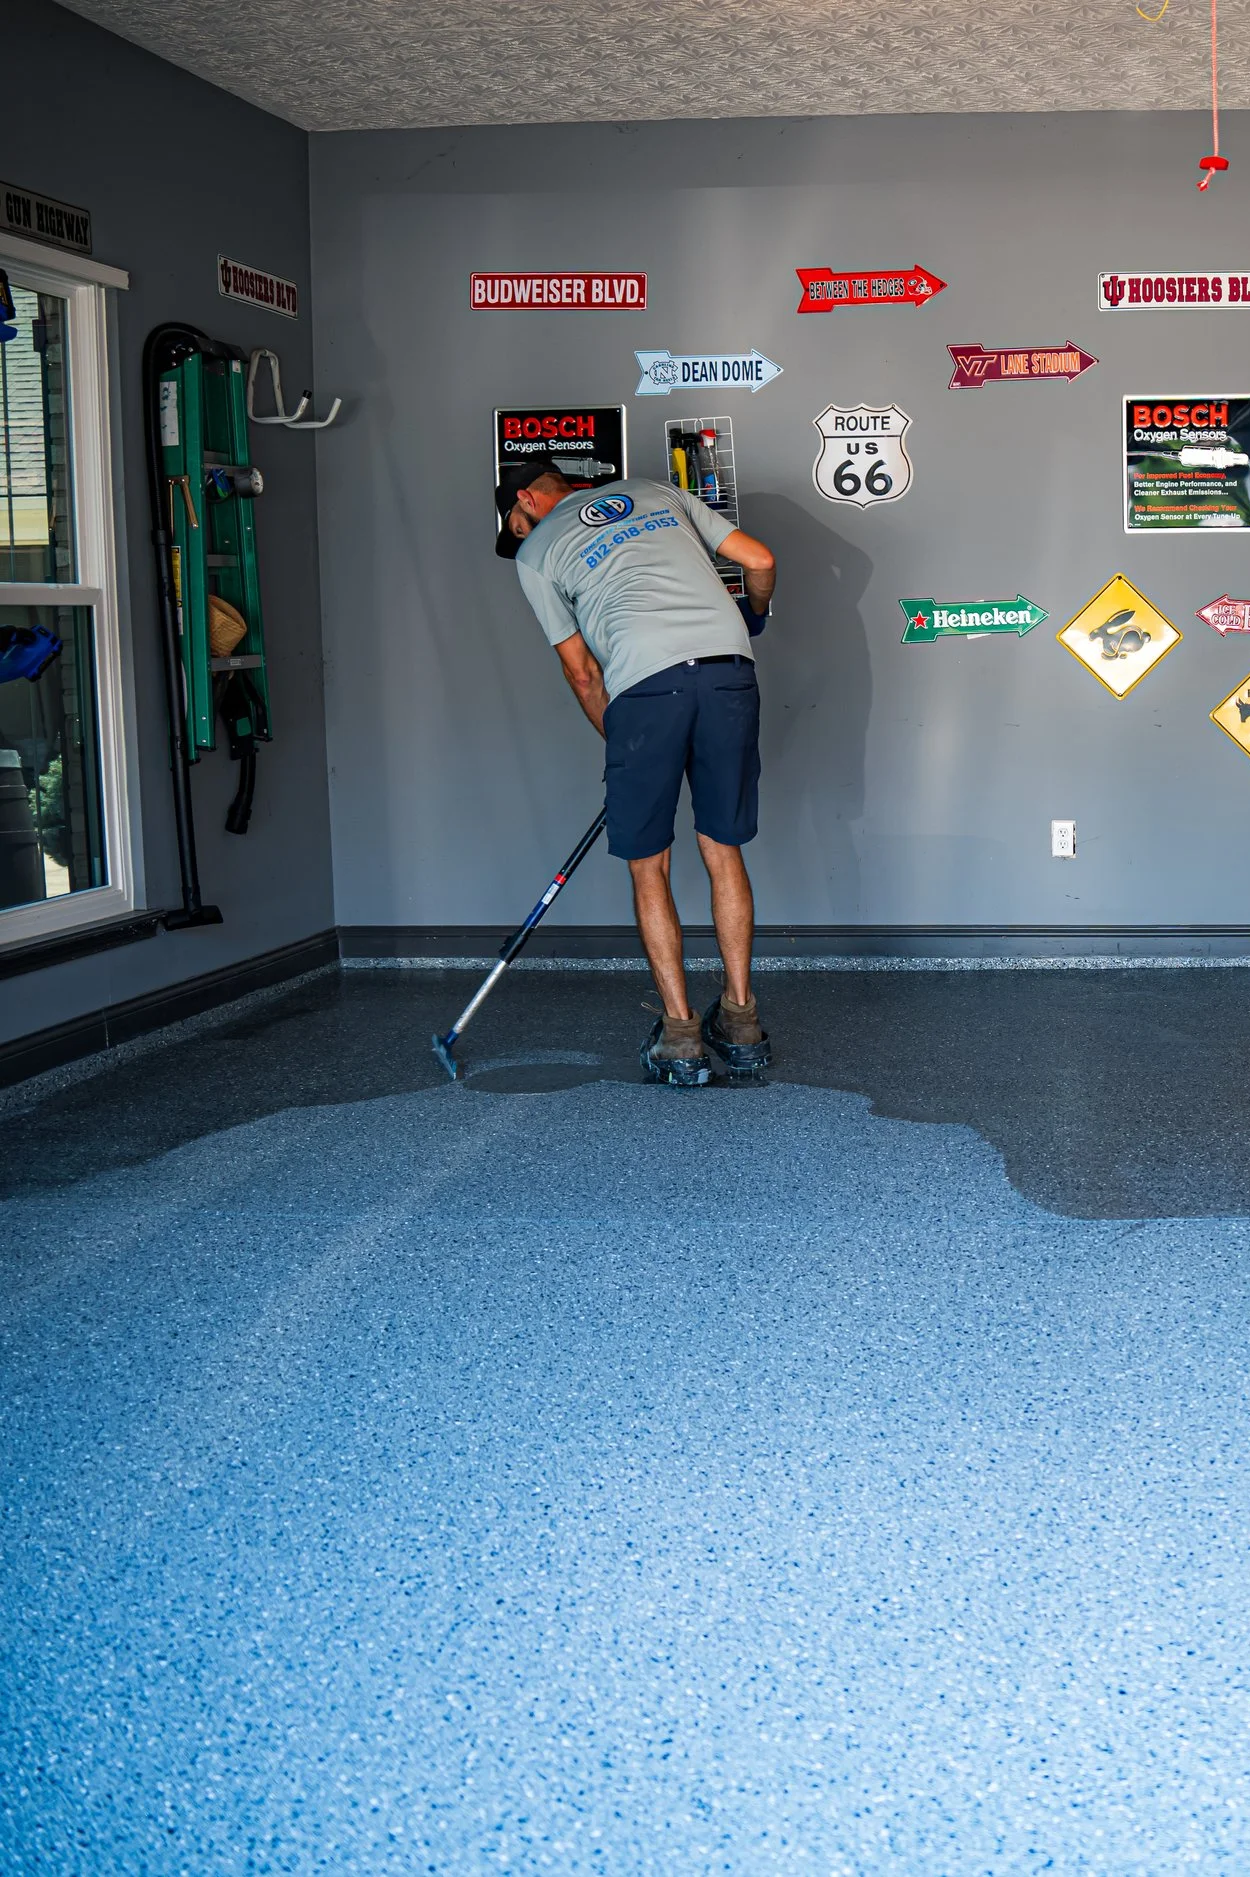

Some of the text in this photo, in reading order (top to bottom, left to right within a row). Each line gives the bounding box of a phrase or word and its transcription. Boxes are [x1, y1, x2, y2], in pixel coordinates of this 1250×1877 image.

[6, 192, 31, 228] GUN
[36, 201, 88, 246] HIGHWAY
[232, 265, 275, 305] HOOSIERS
[276, 281, 297, 312] BLVD
[474, 279, 645, 304] BUDWEISER BLVD.
[809, 278, 904, 300] BETWEEN THE HEDGES
[1128, 277, 1222, 303] HOOSIERS
[682, 361, 718, 382] DEAN
[722, 360, 763, 381] DOME
[1000, 354, 1029, 375] LANE
[1031, 351, 1080, 374] STADIUM
[835, 416, 890, 431] ROUTE
[1134, 404, 1228, 428] BOSCH
[504, 416, 595, 439] BOSCH
[1134, 428, 1227, 443] Oxygen Sensors
[504, 439, 595, 453] Oxygen Sensors
[833, 459, 893, 496] 66
[1156, 481, 1178, 489] Engine
[650, 508, 670, 517] BROS
[586, 517, 679, 568] 812-618-6153
[1211, 614, 1241, 626] COLD
[1218, 605, 1236, 614] ICE
